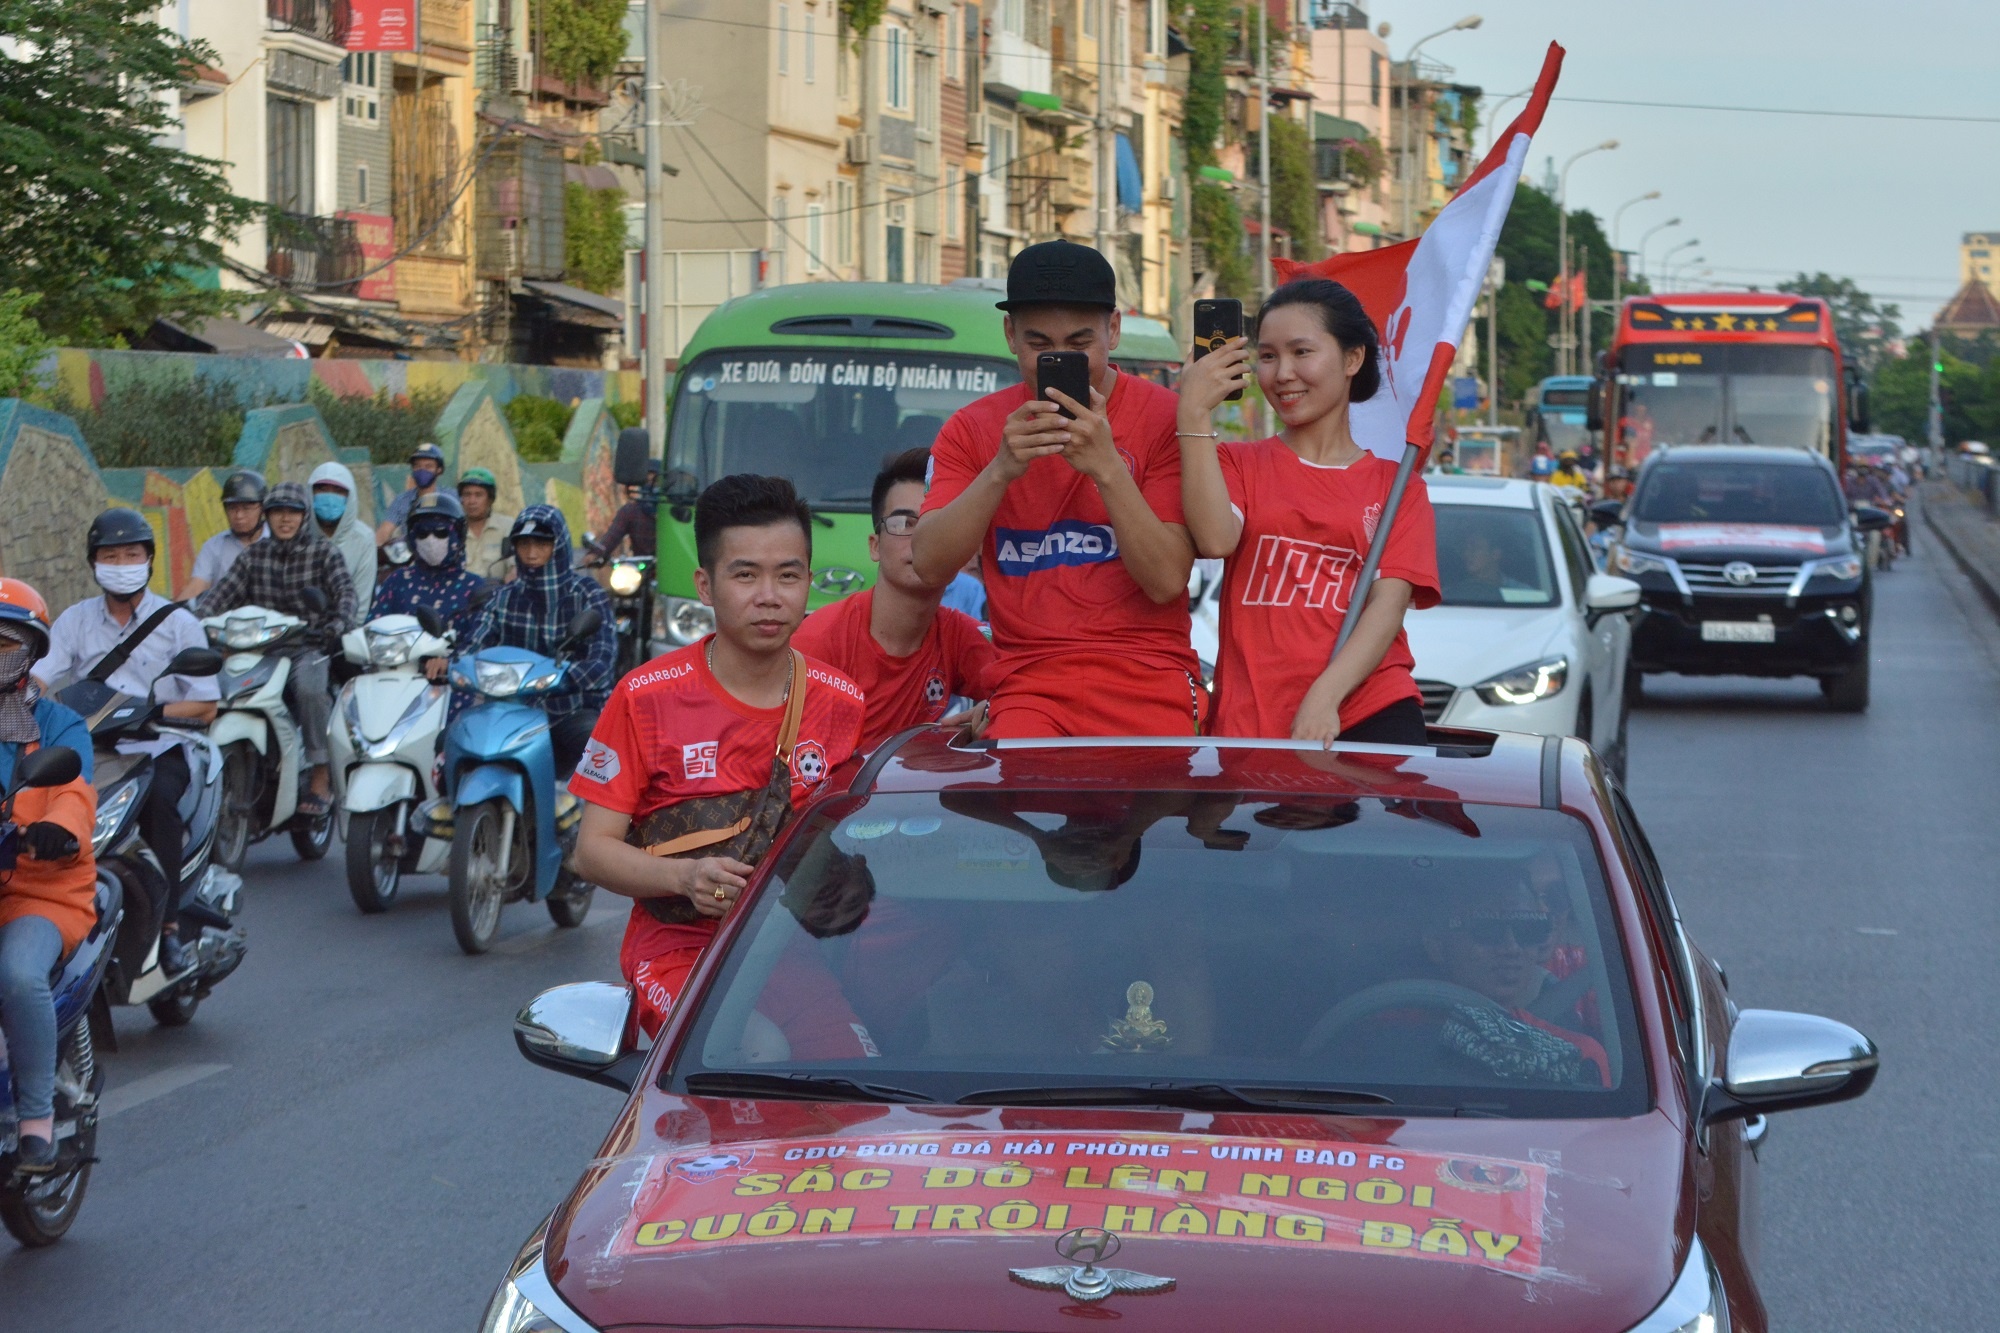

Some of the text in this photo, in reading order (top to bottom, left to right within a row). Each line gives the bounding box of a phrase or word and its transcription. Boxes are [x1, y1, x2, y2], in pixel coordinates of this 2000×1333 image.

[721, 358, 997, 392] XE ĐƯA ĐÓN CÁN BỘ NHÂN VIÊN
[628, 663, 694, 691] JOGARBOLA
[806, 668, 865, 703] JOGARBOLA
[783, 1145, 847, 1161] CĐV
[855, 1142, 940, 1157] BÓNG
[951, 1140, 991, 1155] ĐÁ
[1003, 1139, 1055, 1155] HẢI
[1066, 1141, 1170, 1157] PHÒNG
[1368, 1154, 1405, 1171] FC
[732, 1160, 1436, 1208] SẮC ĐỎ LÊN NGÔI
[634, 1201, 858, 1246] CUỐN
[887, 1199, 1072, 1231] TRÔI
[1101, 1202, 1325, 1242] HÀNG
